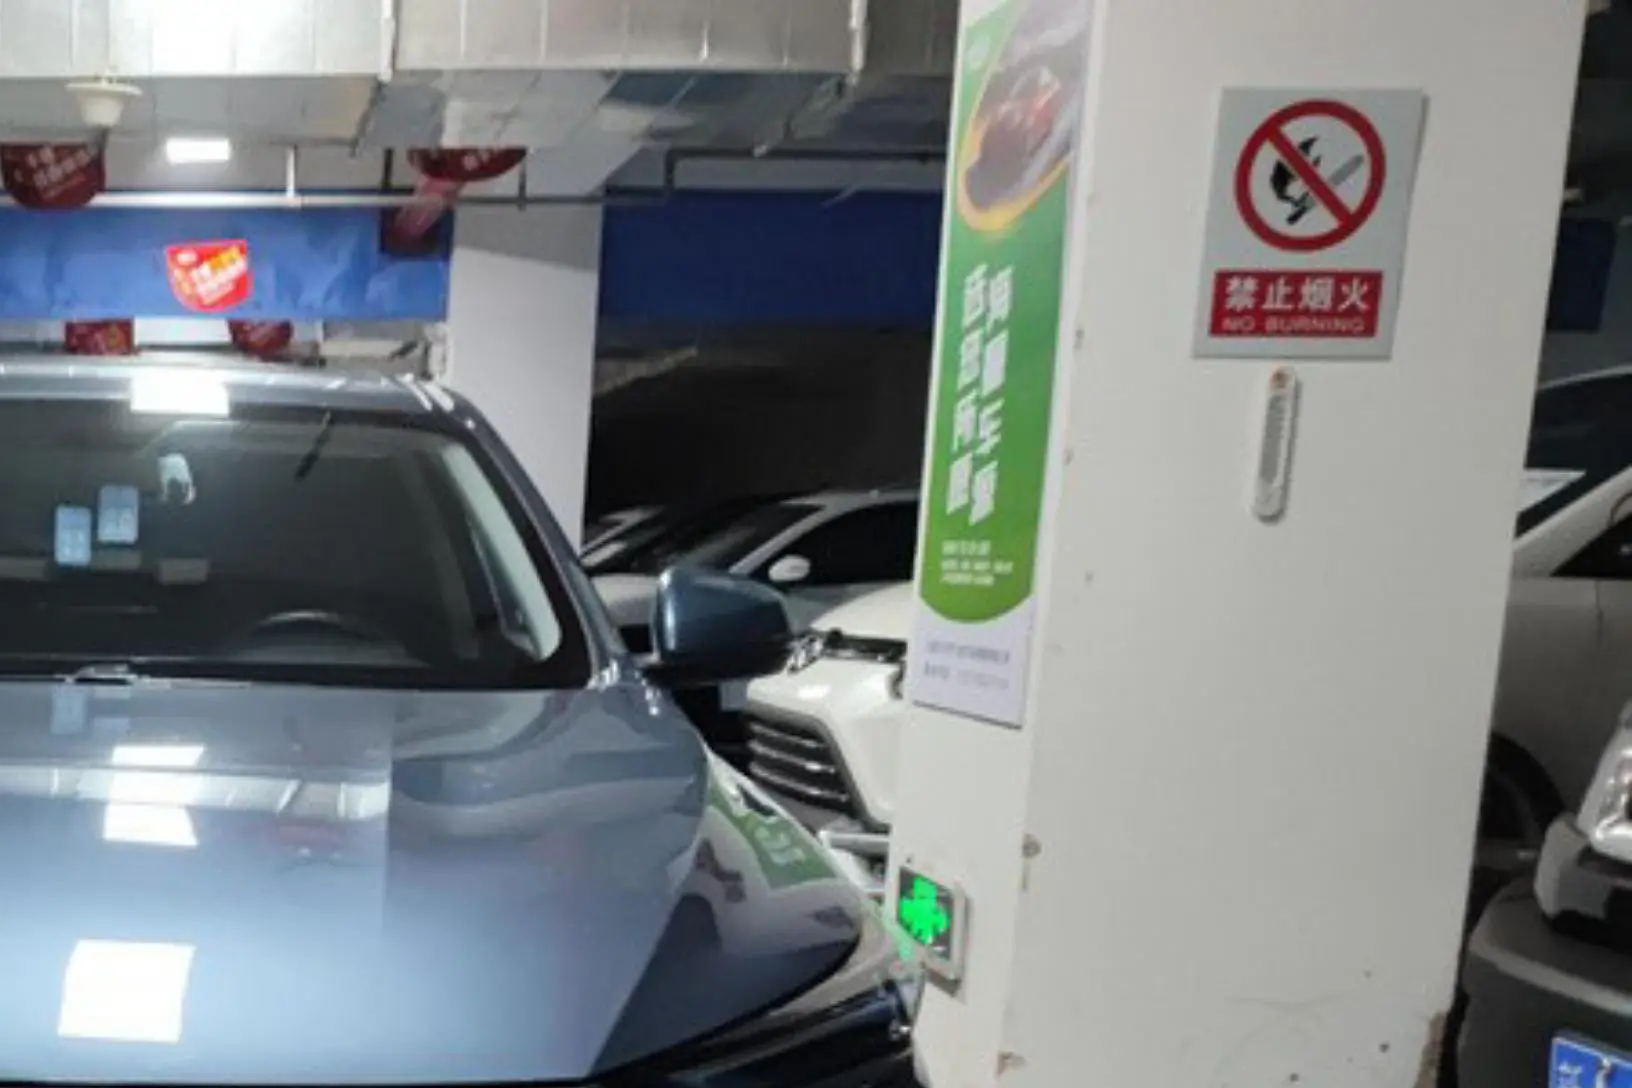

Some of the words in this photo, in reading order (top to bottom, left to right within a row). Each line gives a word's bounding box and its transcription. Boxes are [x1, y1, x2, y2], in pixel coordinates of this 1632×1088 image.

[1224, 274, 1370, 312] 禁止烟火
[1222, 316, 1256, 332] NO
[1265, 316, 1366, 333] BURNING
